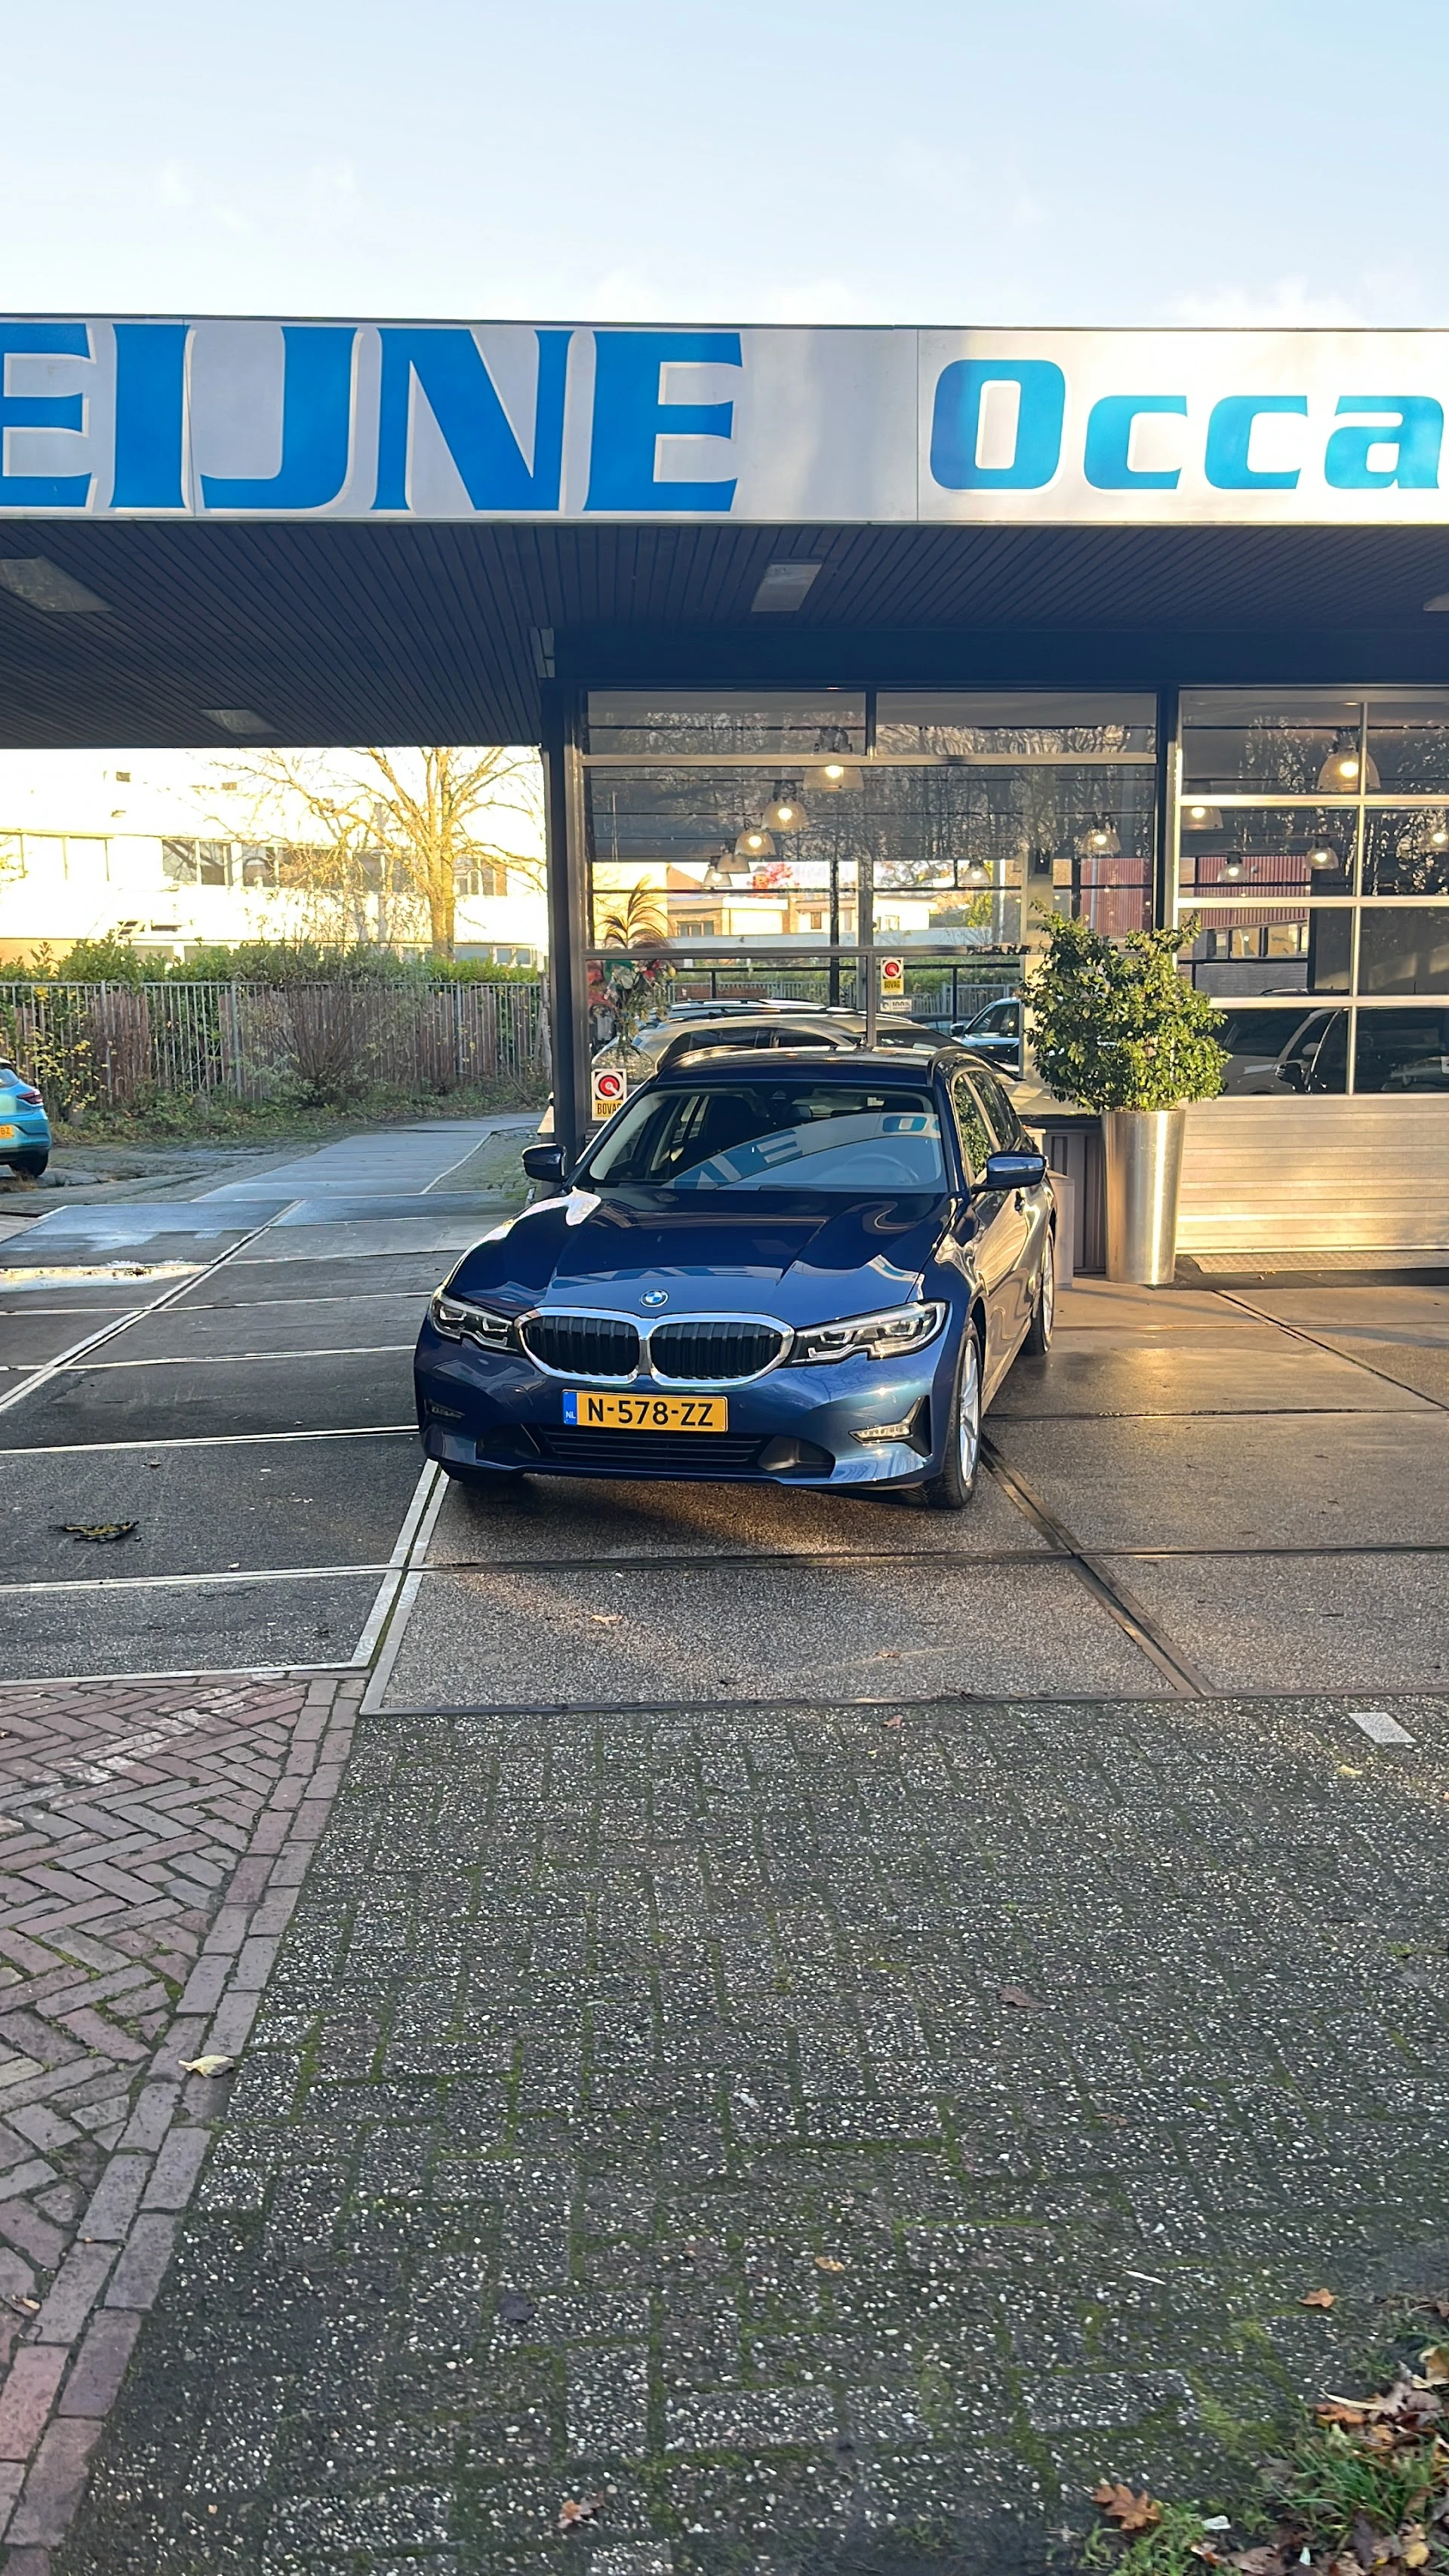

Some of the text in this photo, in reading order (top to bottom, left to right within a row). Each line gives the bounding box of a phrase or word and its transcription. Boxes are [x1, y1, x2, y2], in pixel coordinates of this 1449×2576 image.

[0, 322, 1445, 512] EIJNE Occa
[566, 1398, 713, 1426] NL N-578-ZZ
